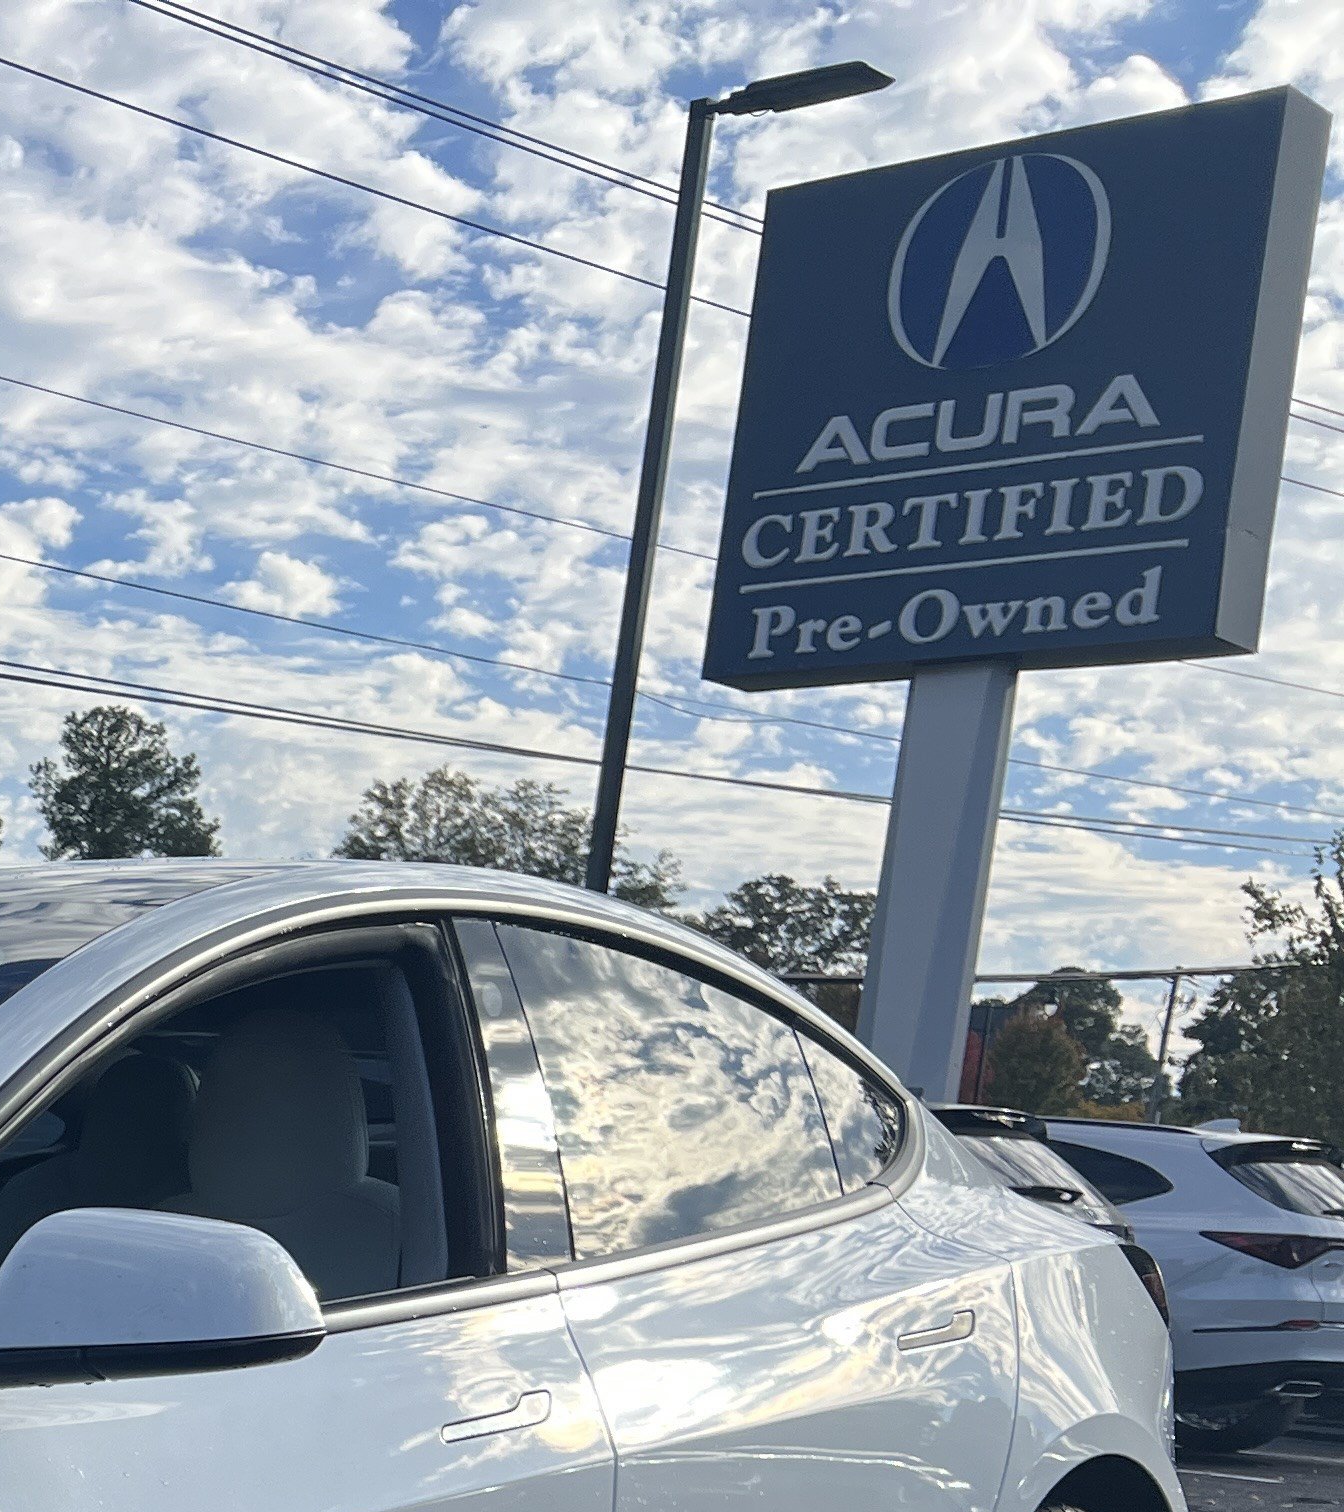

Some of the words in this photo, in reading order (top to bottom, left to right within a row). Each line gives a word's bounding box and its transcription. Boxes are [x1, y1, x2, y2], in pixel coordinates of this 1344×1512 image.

[795, 374, 1160, 474] ACURA
[741, 466, 1205, 569] CERTIFIED
[747, 565, 1162, 660] Pre-Owned
